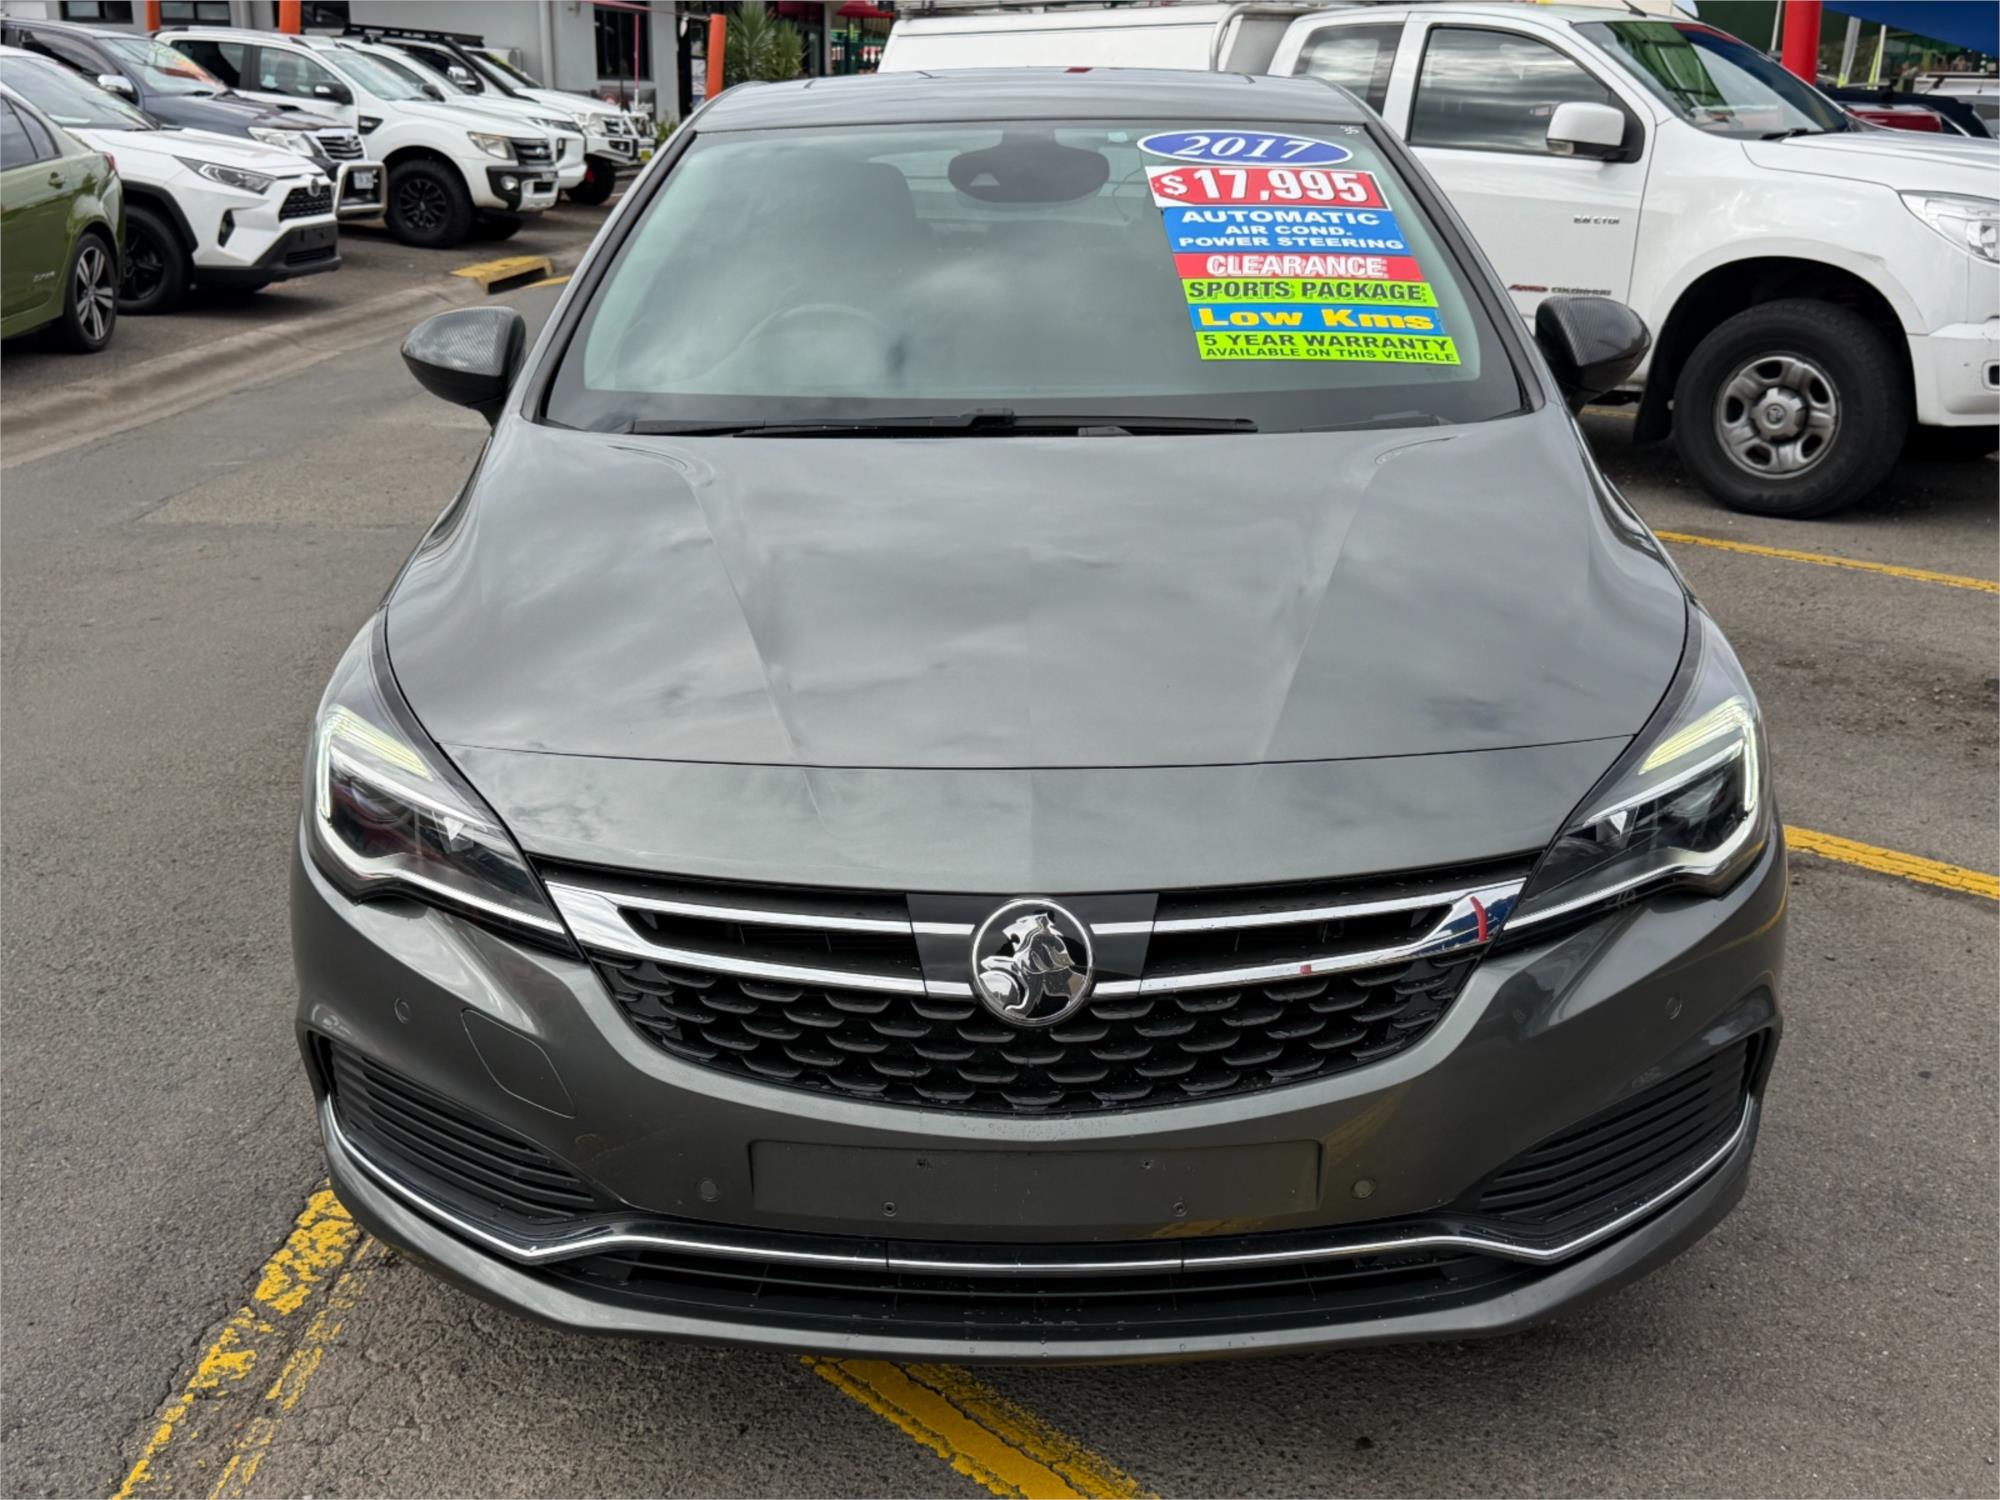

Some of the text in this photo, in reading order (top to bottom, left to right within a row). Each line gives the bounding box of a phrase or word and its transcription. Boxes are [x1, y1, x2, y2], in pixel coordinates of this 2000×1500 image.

[1172, 135, 1316, 158] 2017
[1159, 169, 1368, 202] $17,995
[1181, 211, 1380, 225] AUTOMATIC
[1225, 226, 1353, 236] AIR COND.
[1179, 237, 1404, 249] POWER STEERING
[1206, 255, 1389, 278] CLEARANCE
[1189, 281, 1426, 302] SPORTS PACKAGE
[1199, 308, 1434, 329] Low Kms
[1203, 334, 1448, 351] 5 YEAR WARRANTY
[1206, 348, 1456, 362] AVAILABLE ON THIS VEHICLE
